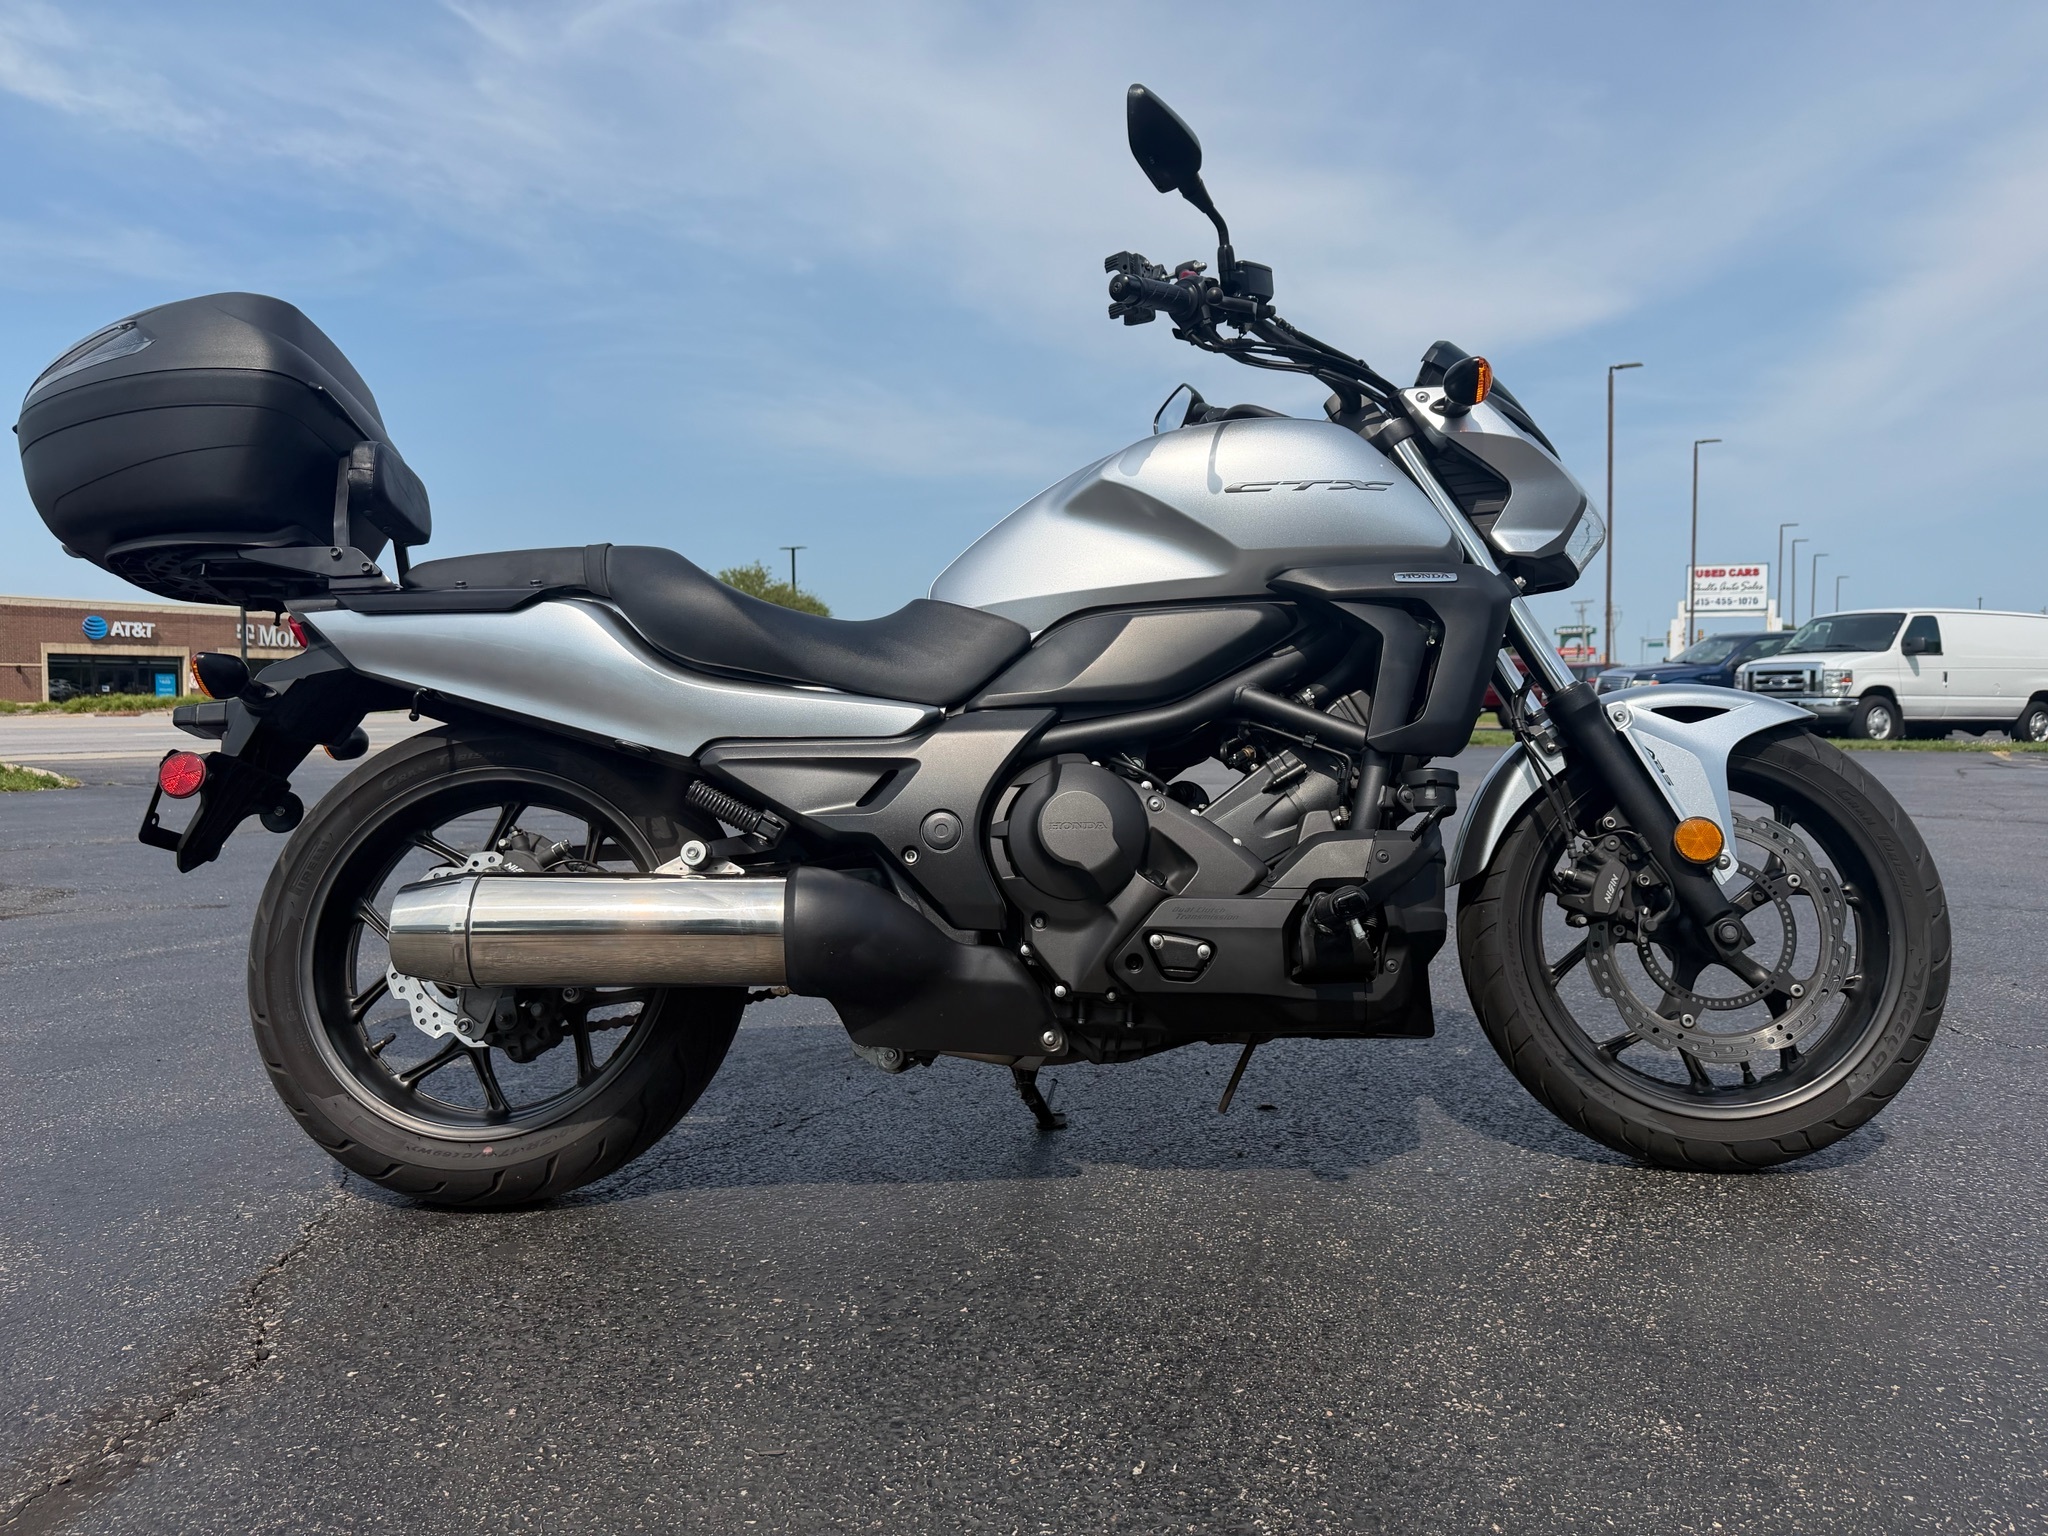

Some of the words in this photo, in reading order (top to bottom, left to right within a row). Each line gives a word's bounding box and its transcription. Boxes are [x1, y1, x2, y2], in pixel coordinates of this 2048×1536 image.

[1224, 479, 1394, 494] CTX
[1696, 569, 1726, 578] USED
[1728, 567, 1760, 577] CARS
[110, 621, 156, 639] AT&T
[1643, 745, 1675, 786] ABS
[1048, 820, 1108, 831] HONDA
[288, 836, 331, 897] PIRELLI
[1175, 912, 1240, 920] Transmission
